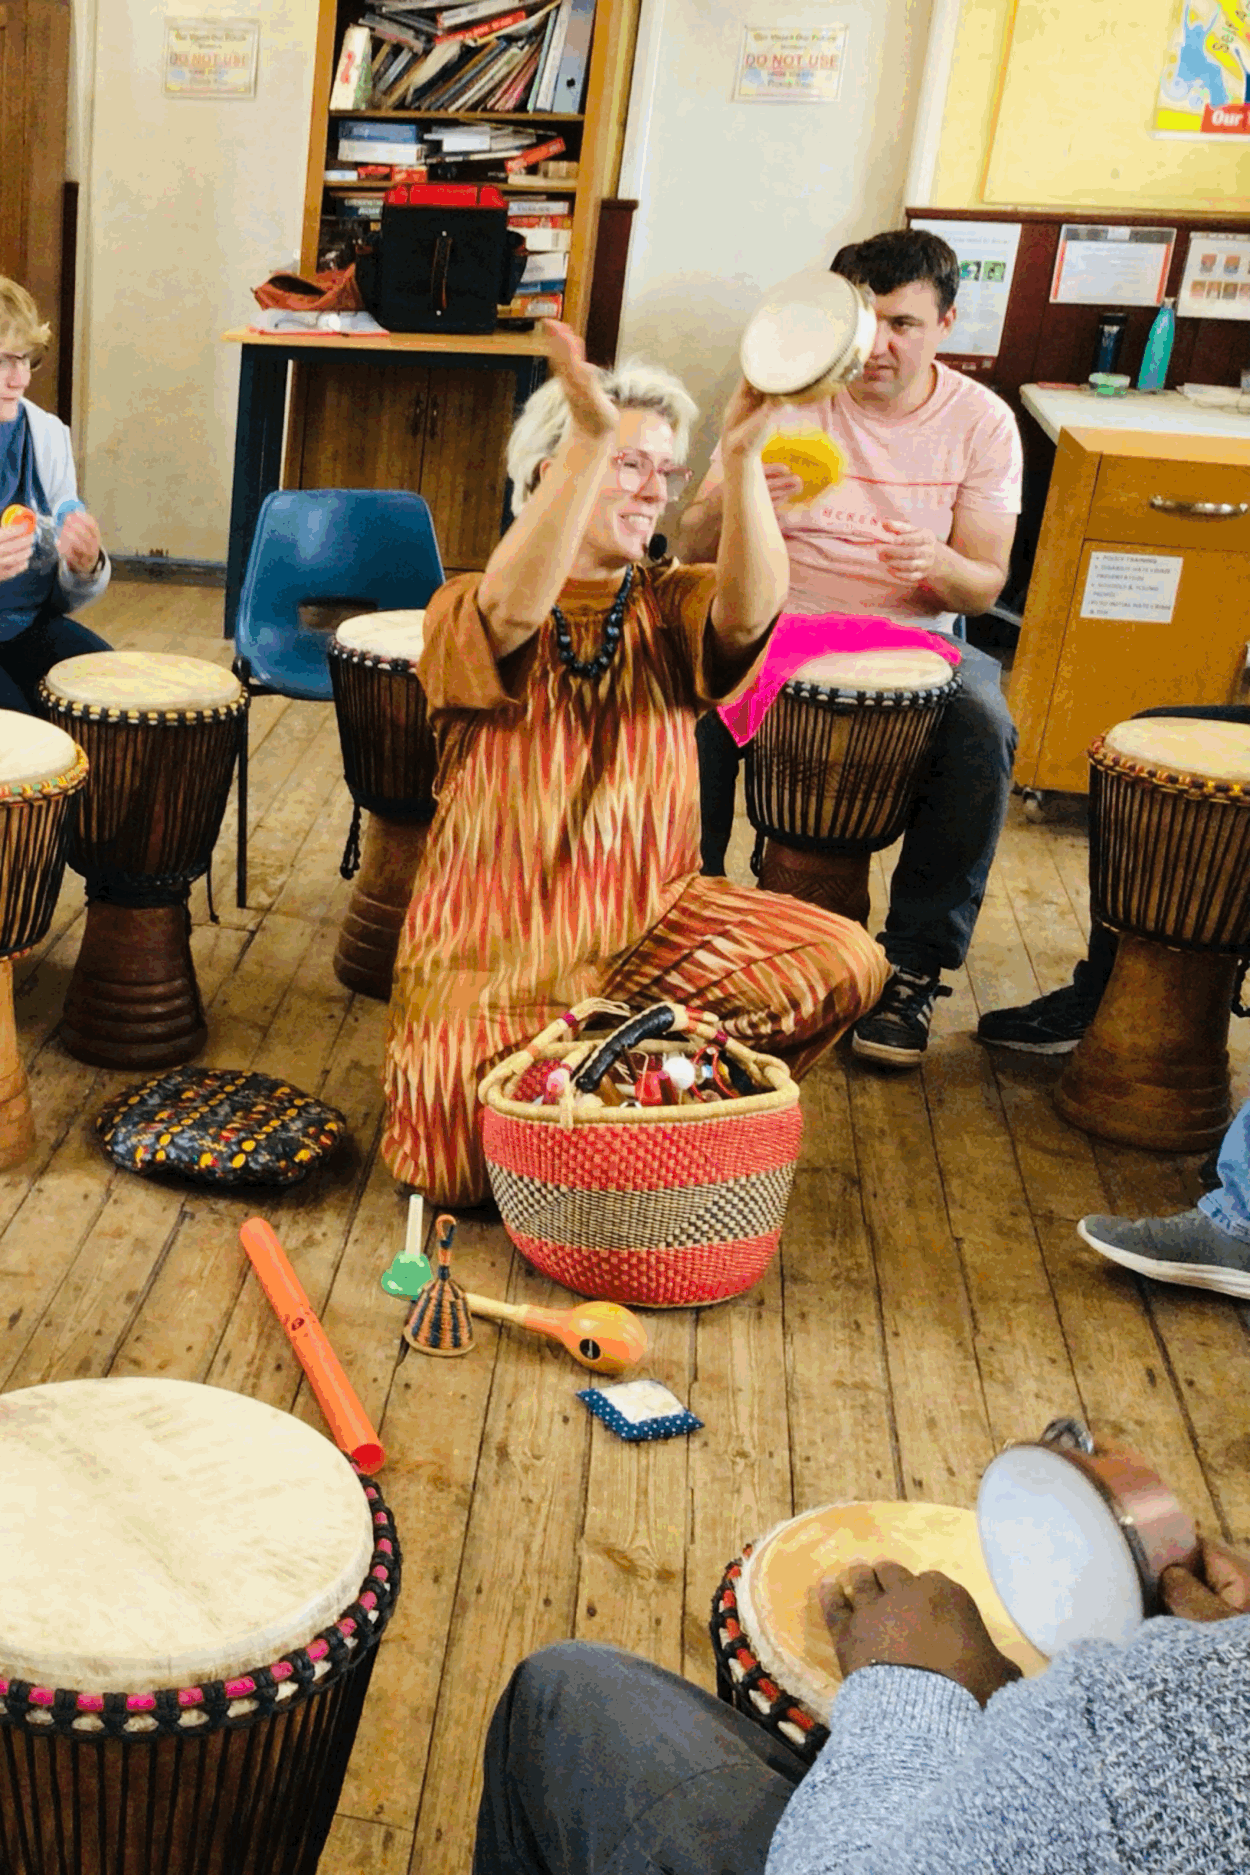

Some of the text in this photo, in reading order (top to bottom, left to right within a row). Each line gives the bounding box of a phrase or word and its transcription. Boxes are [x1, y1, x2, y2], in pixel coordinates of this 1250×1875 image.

[1212, 20, 1240, 54] Self
[744, 53, 839, 68] DO NOT USE
[1211, 109, 1244, 126] Our
